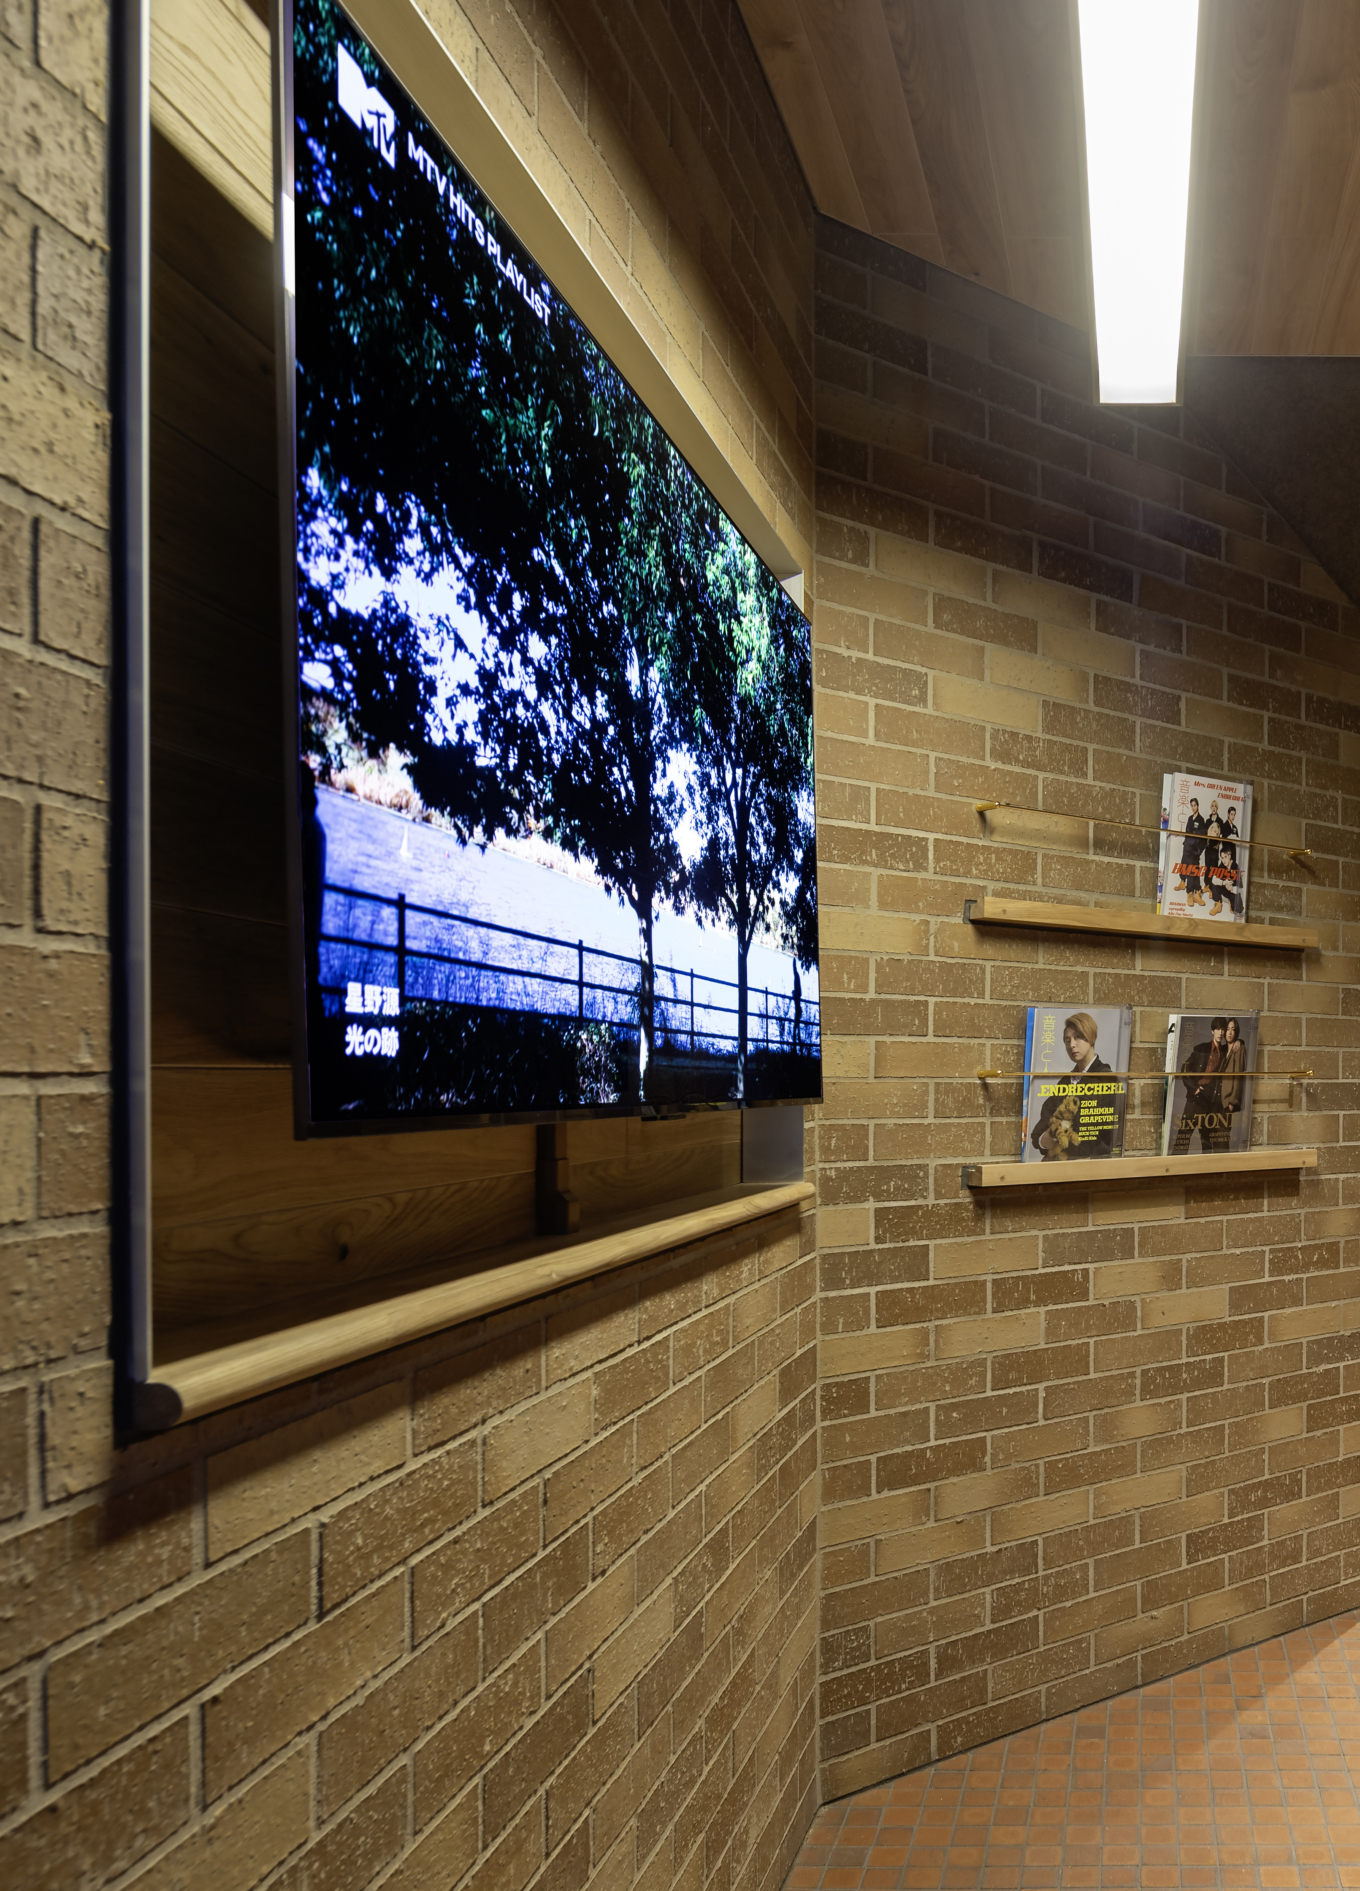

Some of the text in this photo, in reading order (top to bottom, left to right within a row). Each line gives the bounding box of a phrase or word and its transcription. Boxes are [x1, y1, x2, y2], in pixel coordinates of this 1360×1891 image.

[407, 130, 551, 326] MTV HITS PLAYLIST
[345, 981, 400, 1016] 星野源
[345, 1023, 399, 1058] 光の跡
[1080, 1100, 1098, 1108] ZION
[1080, 1107, 1114, 1115] BRAHMAN
[1079, 1115, 1119, 1124] GRAPEVINE
